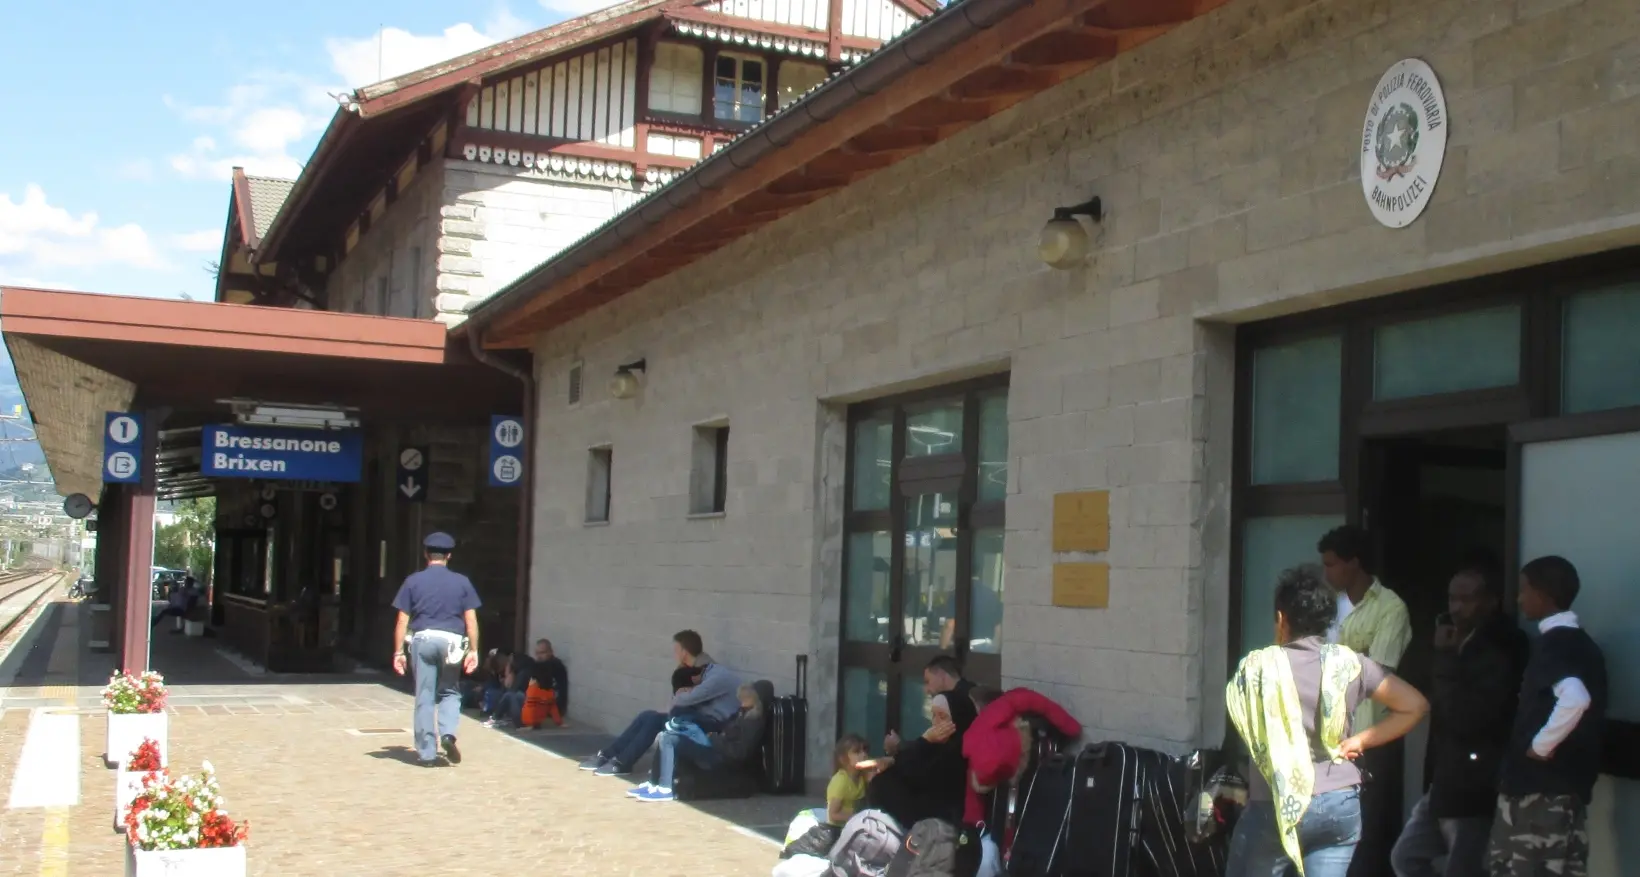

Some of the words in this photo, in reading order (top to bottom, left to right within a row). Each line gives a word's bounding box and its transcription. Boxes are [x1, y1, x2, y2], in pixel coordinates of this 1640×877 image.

[1363, 120, 1374, 152] POSTO
[1372, 104, 1380, 117] DI
[1378, 72, 1405, 103] POLIZIA
[1406, 72, 1442, 131] FERROVIARIA
[1371, 174, 1428, 213] BAHNPOLIZEI
[120, 421, 128, 438] 1
[214, 430, 341, 453] Bressanone
[213, 452, 286, 472] Brixen
